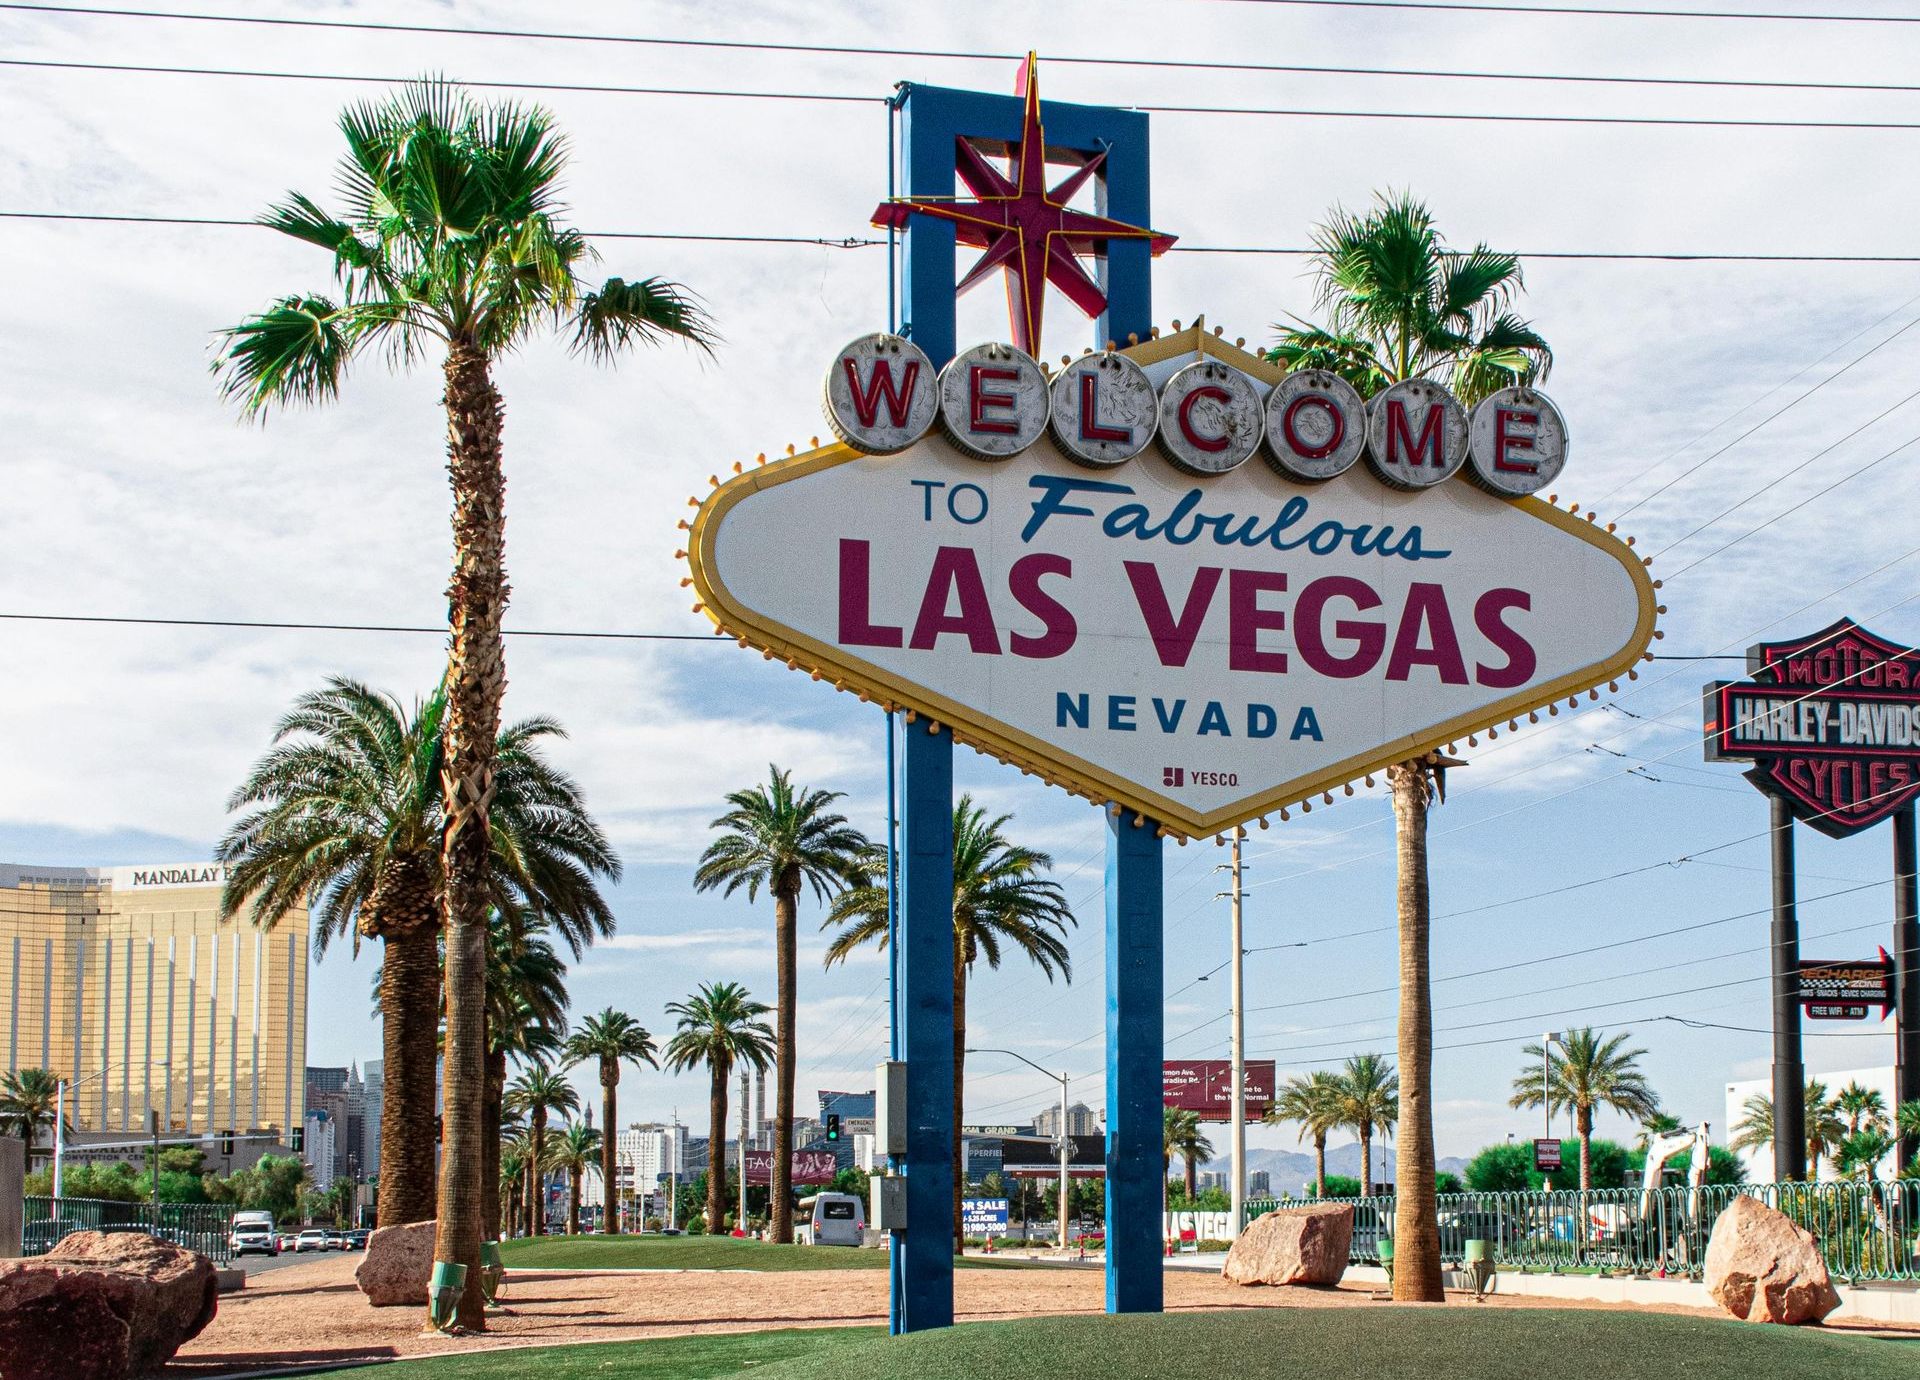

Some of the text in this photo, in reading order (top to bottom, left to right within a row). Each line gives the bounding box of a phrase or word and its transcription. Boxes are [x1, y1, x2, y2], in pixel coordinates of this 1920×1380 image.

[843, 357, 1540, 474] WELCOME
[910, 474, 1452, 560] TO Fabulous
[838, 537, 1538, 688] LAS VEGAS
[1788, 637, 1910, 689] MOTOR
[1056, 691, 1325, 742] NEVADA
[1790, 760, 1911, 814] CYCLES
[134, 867, 219, 886] MANDALAY
[1850, 980, 1883, 988] ZONE
[1817, 989, 1838, 998] SNACKS
[1840, 989, 1860, 998] DEVICE
[1860, 989, 1887, 998] CHARGING
[1811, 1006, 1828, 1015] FREE
[1850, 1006, 1864, 1016] ATM
[961, 1126, 1017, 1135] GM GRAND
[62, 1153, 120, 1161] ONVENTION
[745, 1157, 775, 1170] TAO
[976, 1200, 1006, 1210] SALE
[980, 1214, 998, 1222] ACRES
[970, 1222, 1007, 1232] 980-5000
